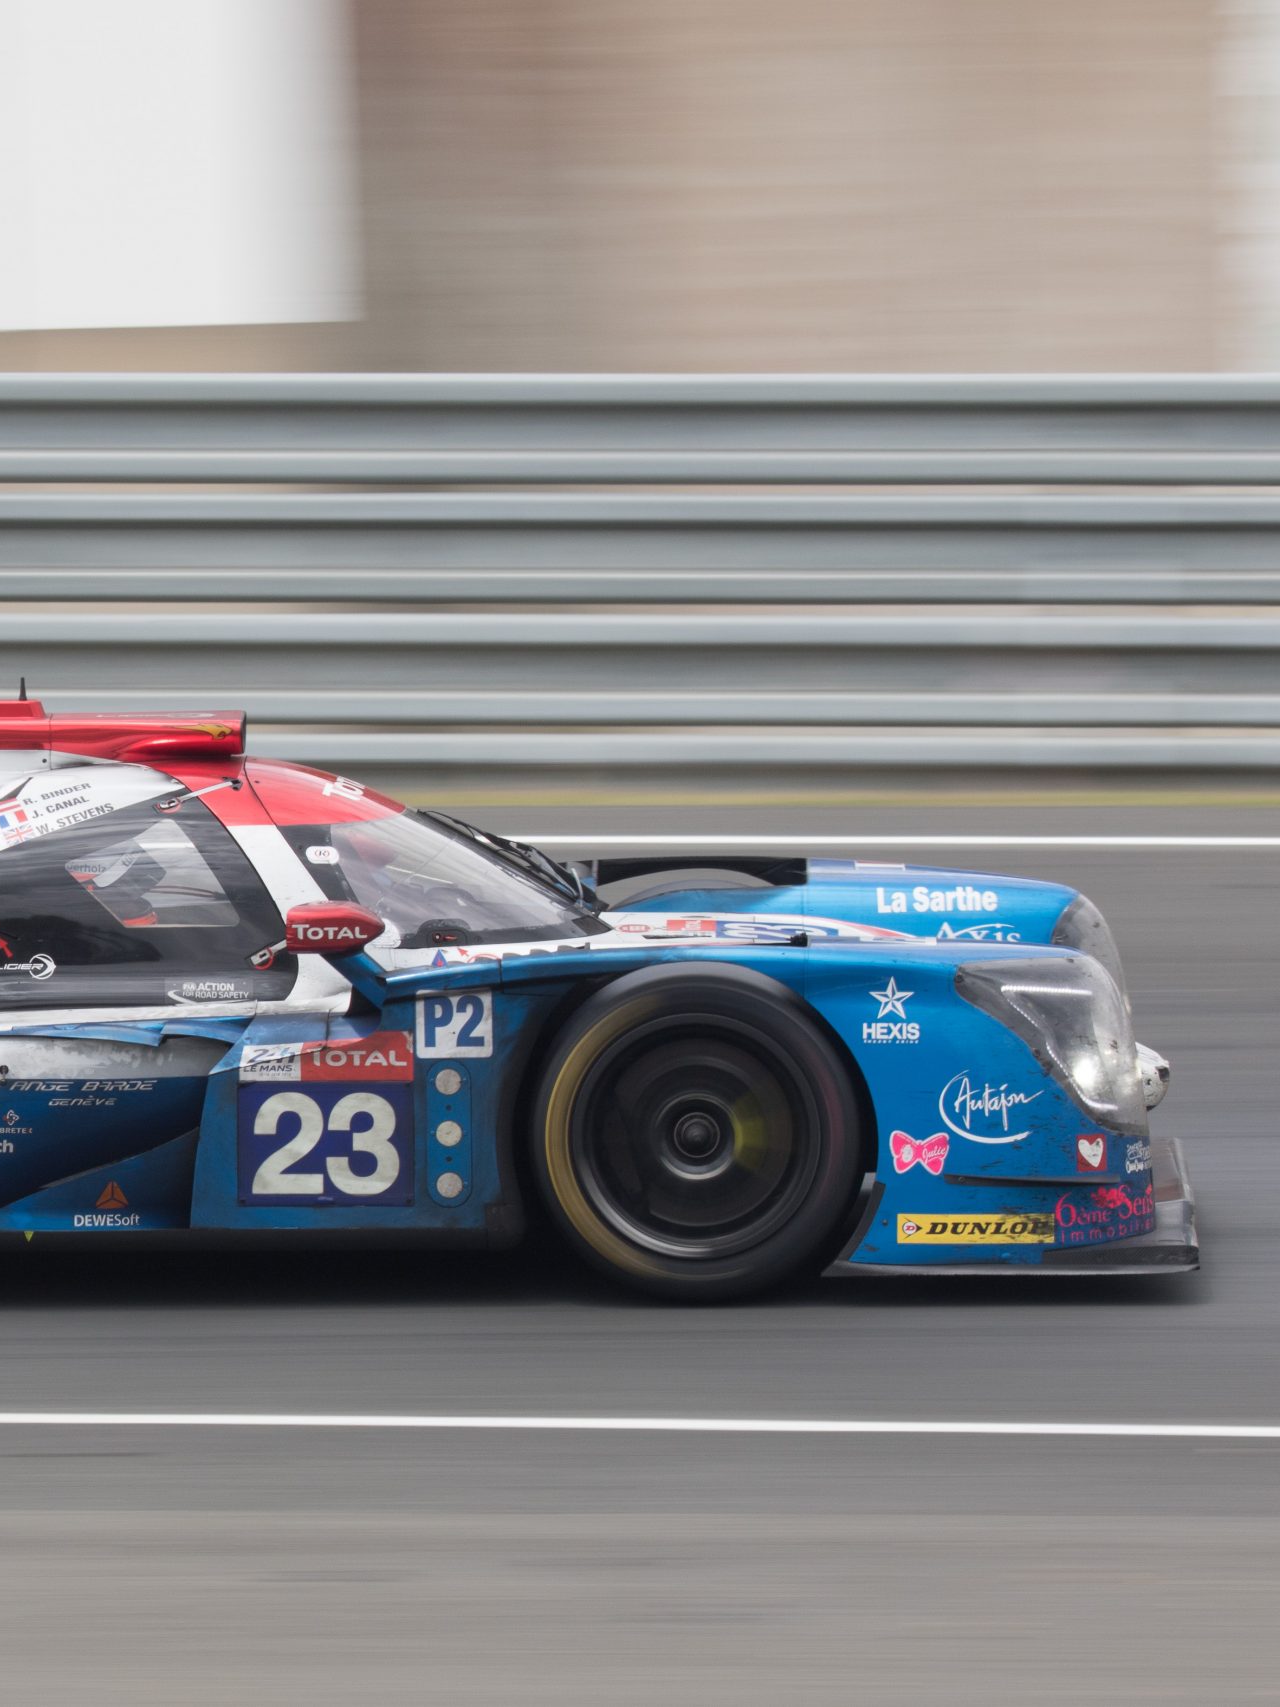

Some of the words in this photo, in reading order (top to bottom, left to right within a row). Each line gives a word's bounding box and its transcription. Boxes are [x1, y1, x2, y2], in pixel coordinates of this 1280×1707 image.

[40, 782, 91, 801] BINDER
[32, 809, 43, 819] J.
[46, 795, 91, 814] CANAL
[36, 824, 54, 835] W.
[56, 802, 114, 828] STEVENS
[876, 887, 907, 913] La
[912, 886, 999, 912] Sarthe
[292, 924, 368, 940] TOTAL
[195, 991, 218, 999] ROAD
[218, 991, 250, 999] SAFETY
[197, 982, 235, 991] ACTION
[423, 994, 485, 1048] P2
[862, 1022, 920, 1040] HEXIS
[243, 1065, 257, 1073] LE
[259, 1064, 293, 1072] MANS
[9, 1080, 74, 1092] ANGE
[81, 1079, 158, 1092] BARDE
[954, 1077, 1045, 1132] Autajon
[251, 1091, 400, 1196] 23
[922, 1146, 946, 1162] Julie
[73, 1213, 140, 1228] DEWESoft
[926, 1222, 1050, 1235] DUNLOP
